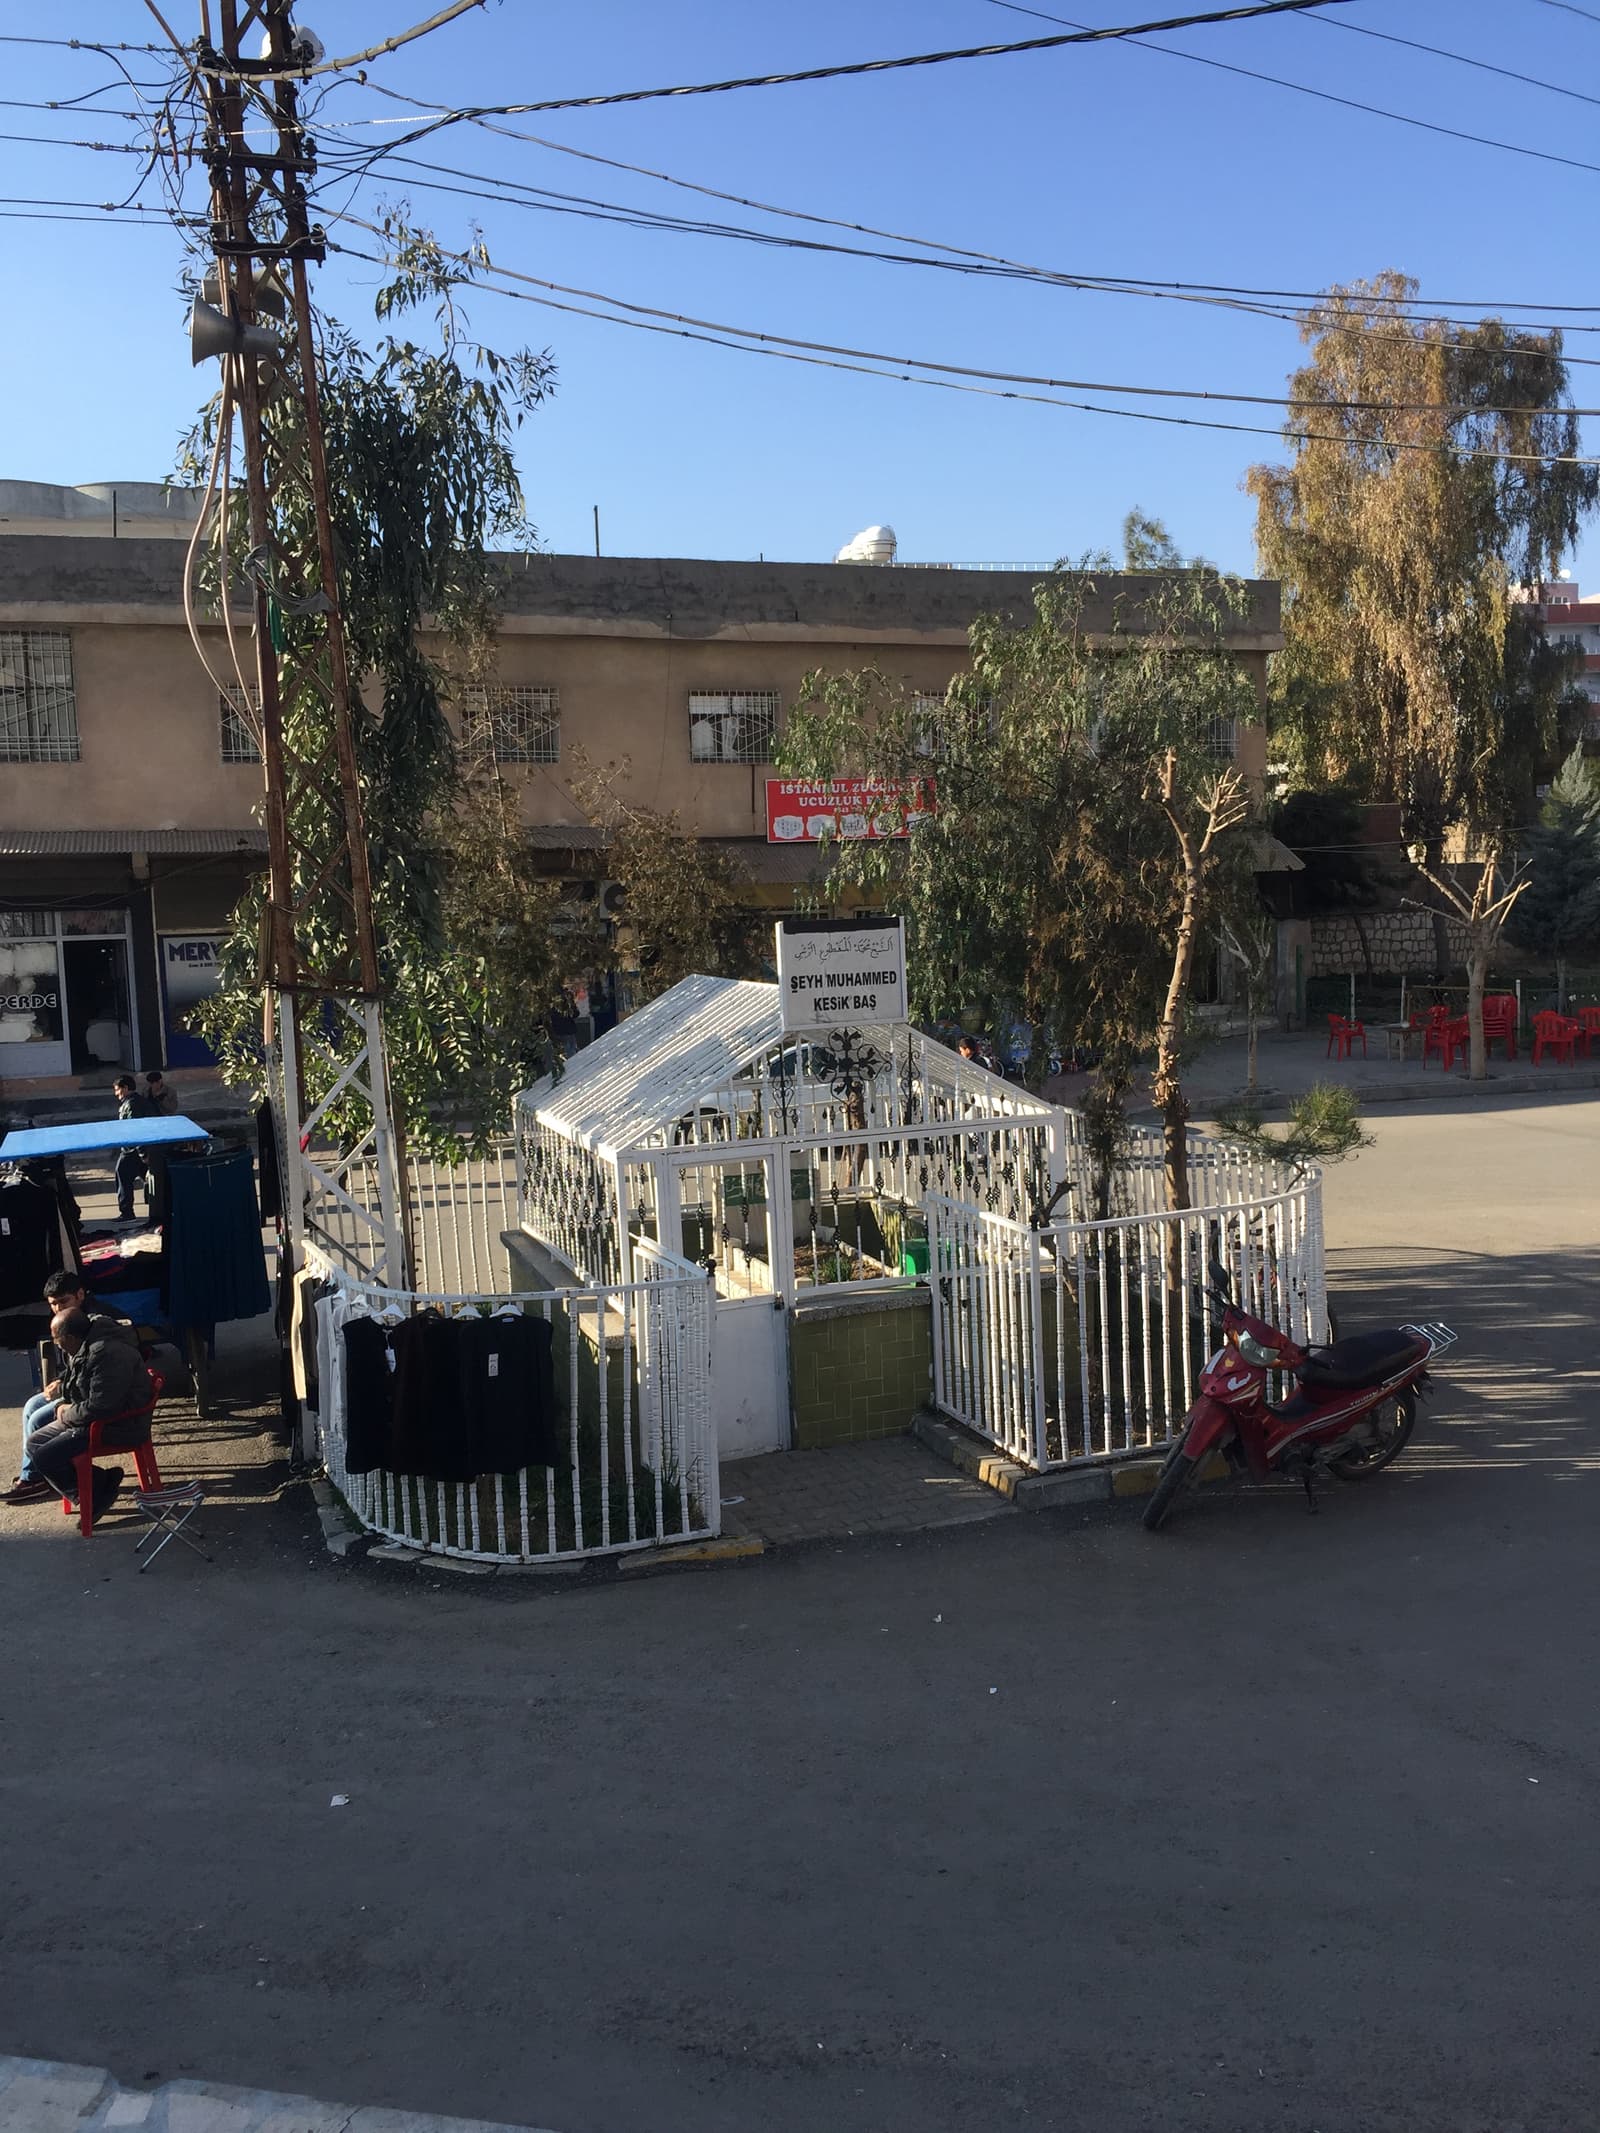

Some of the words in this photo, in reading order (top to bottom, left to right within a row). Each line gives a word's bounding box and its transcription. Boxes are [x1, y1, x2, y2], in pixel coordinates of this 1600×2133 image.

[799, 795, 862, 807] UCUZLUK
[791, 974, 823, 993] ŞEYH
[826, 971, 897, 988] MUHAMMED
[853, 995, 877, 1011] BAŞ
